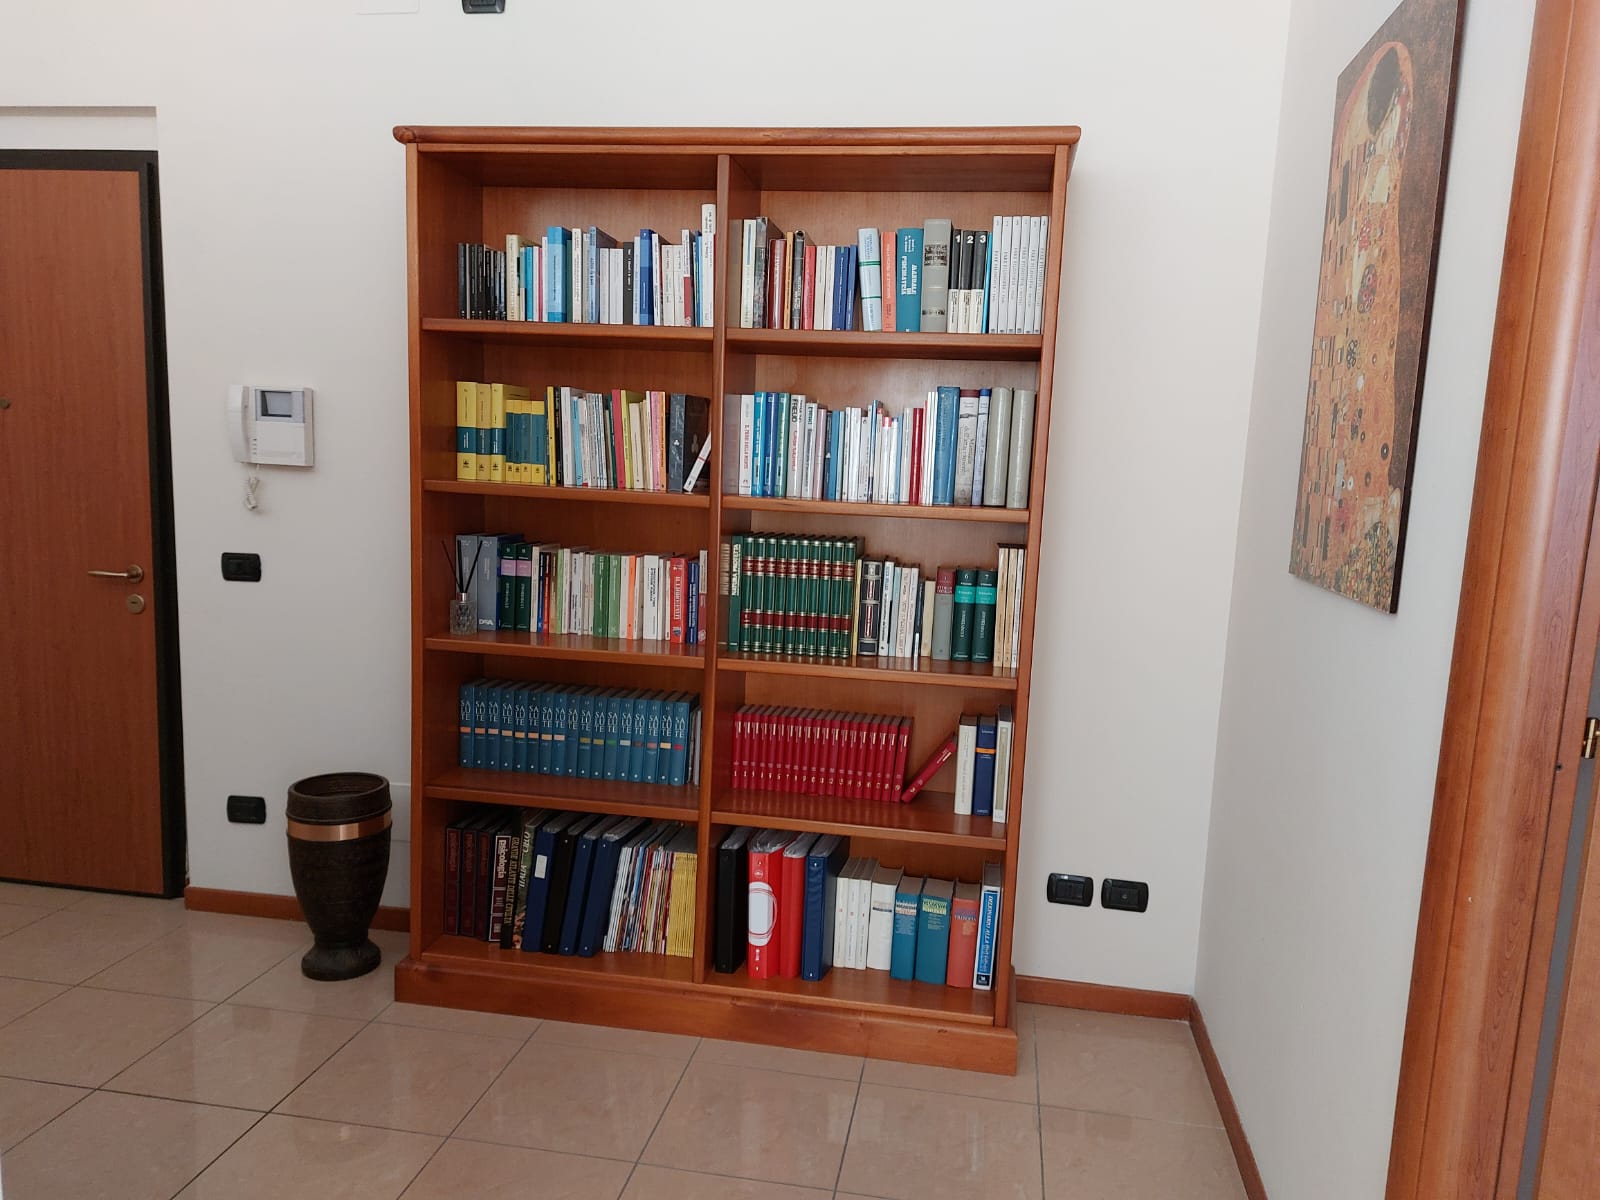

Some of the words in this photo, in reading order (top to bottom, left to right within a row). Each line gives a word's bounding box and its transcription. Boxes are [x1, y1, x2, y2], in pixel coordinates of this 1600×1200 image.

[980, 235, 986, 243] 3
[511, 837, 519, 858] GRANDE
[497, 840, 507, 878] psicologia
[508, 860, 517, 884] ATLANTE
